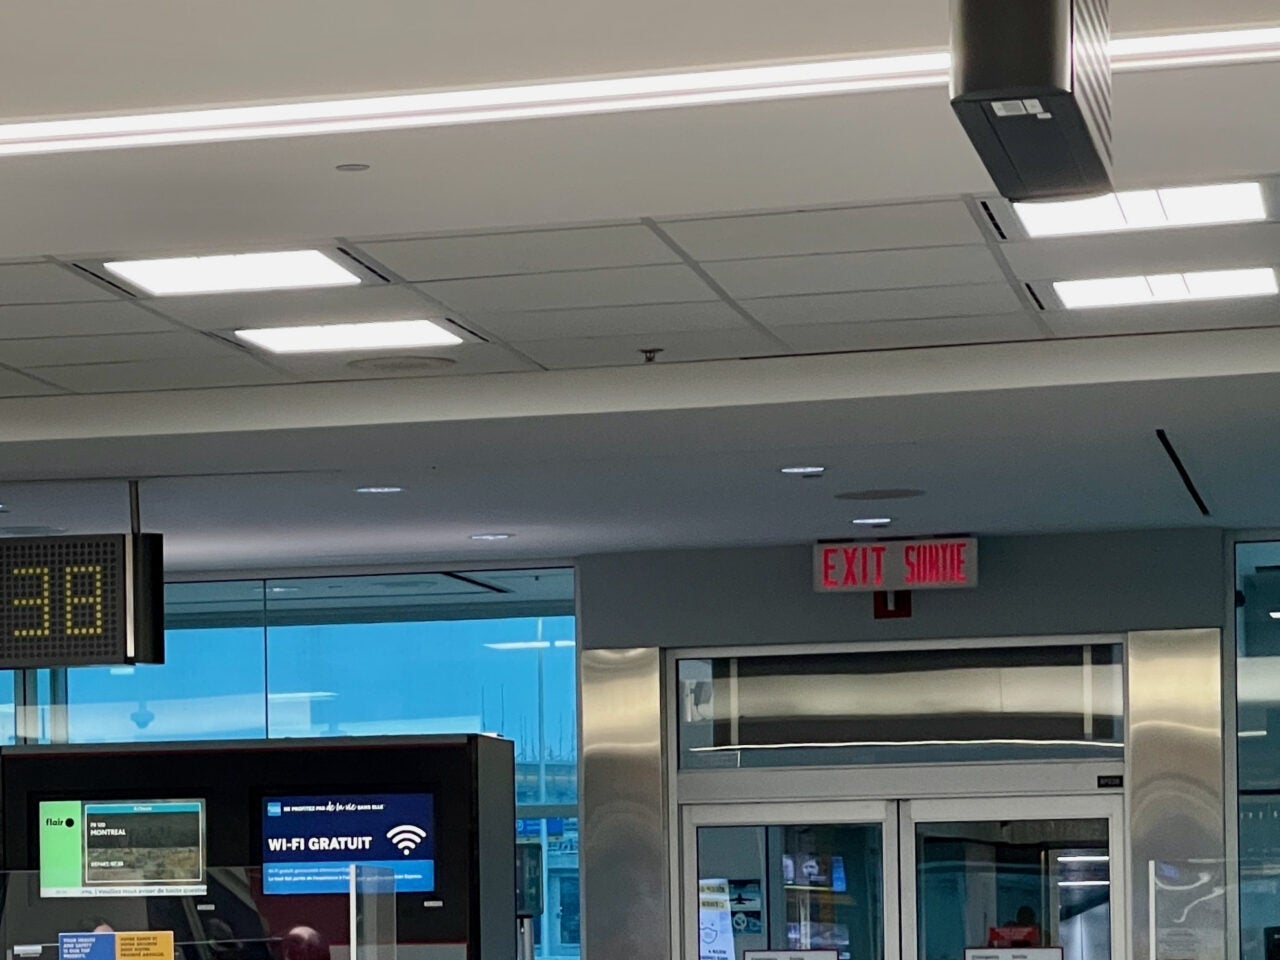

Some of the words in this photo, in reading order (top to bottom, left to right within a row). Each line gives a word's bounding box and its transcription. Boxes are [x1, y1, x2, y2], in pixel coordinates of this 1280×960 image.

[823, 546, 887, 588] EXIT
[904, 543, 967, 584] SORTIE
[46, 818, 63, 826] flair
[90, 828, 126, 836] MONTREAL
[267, 837, 305, 851] WI-FI
[308, 836, 372, 850] GRATUIT
